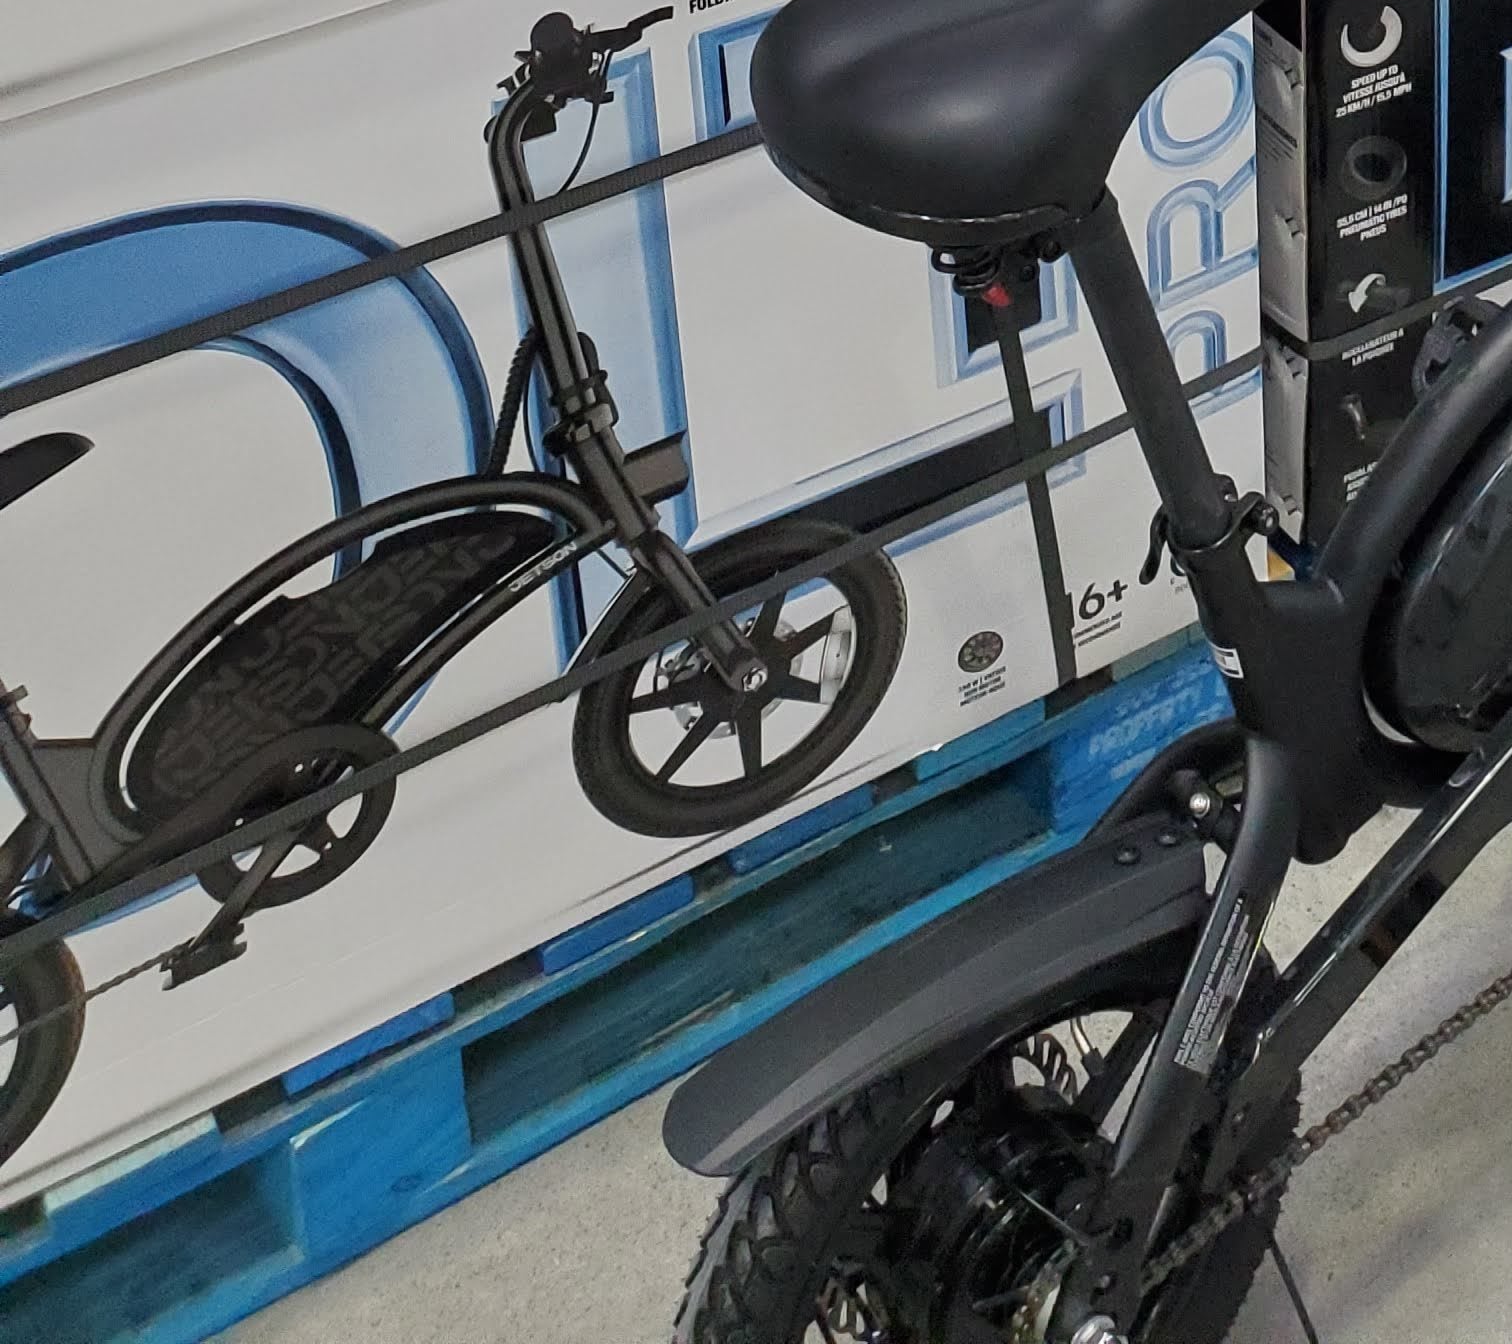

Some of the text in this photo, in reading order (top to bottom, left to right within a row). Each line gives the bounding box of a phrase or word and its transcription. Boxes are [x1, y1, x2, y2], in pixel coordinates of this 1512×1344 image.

[1351, 64, 1398, 89] SPEED UP TO
[507, 540, 578, 593] JETSON
